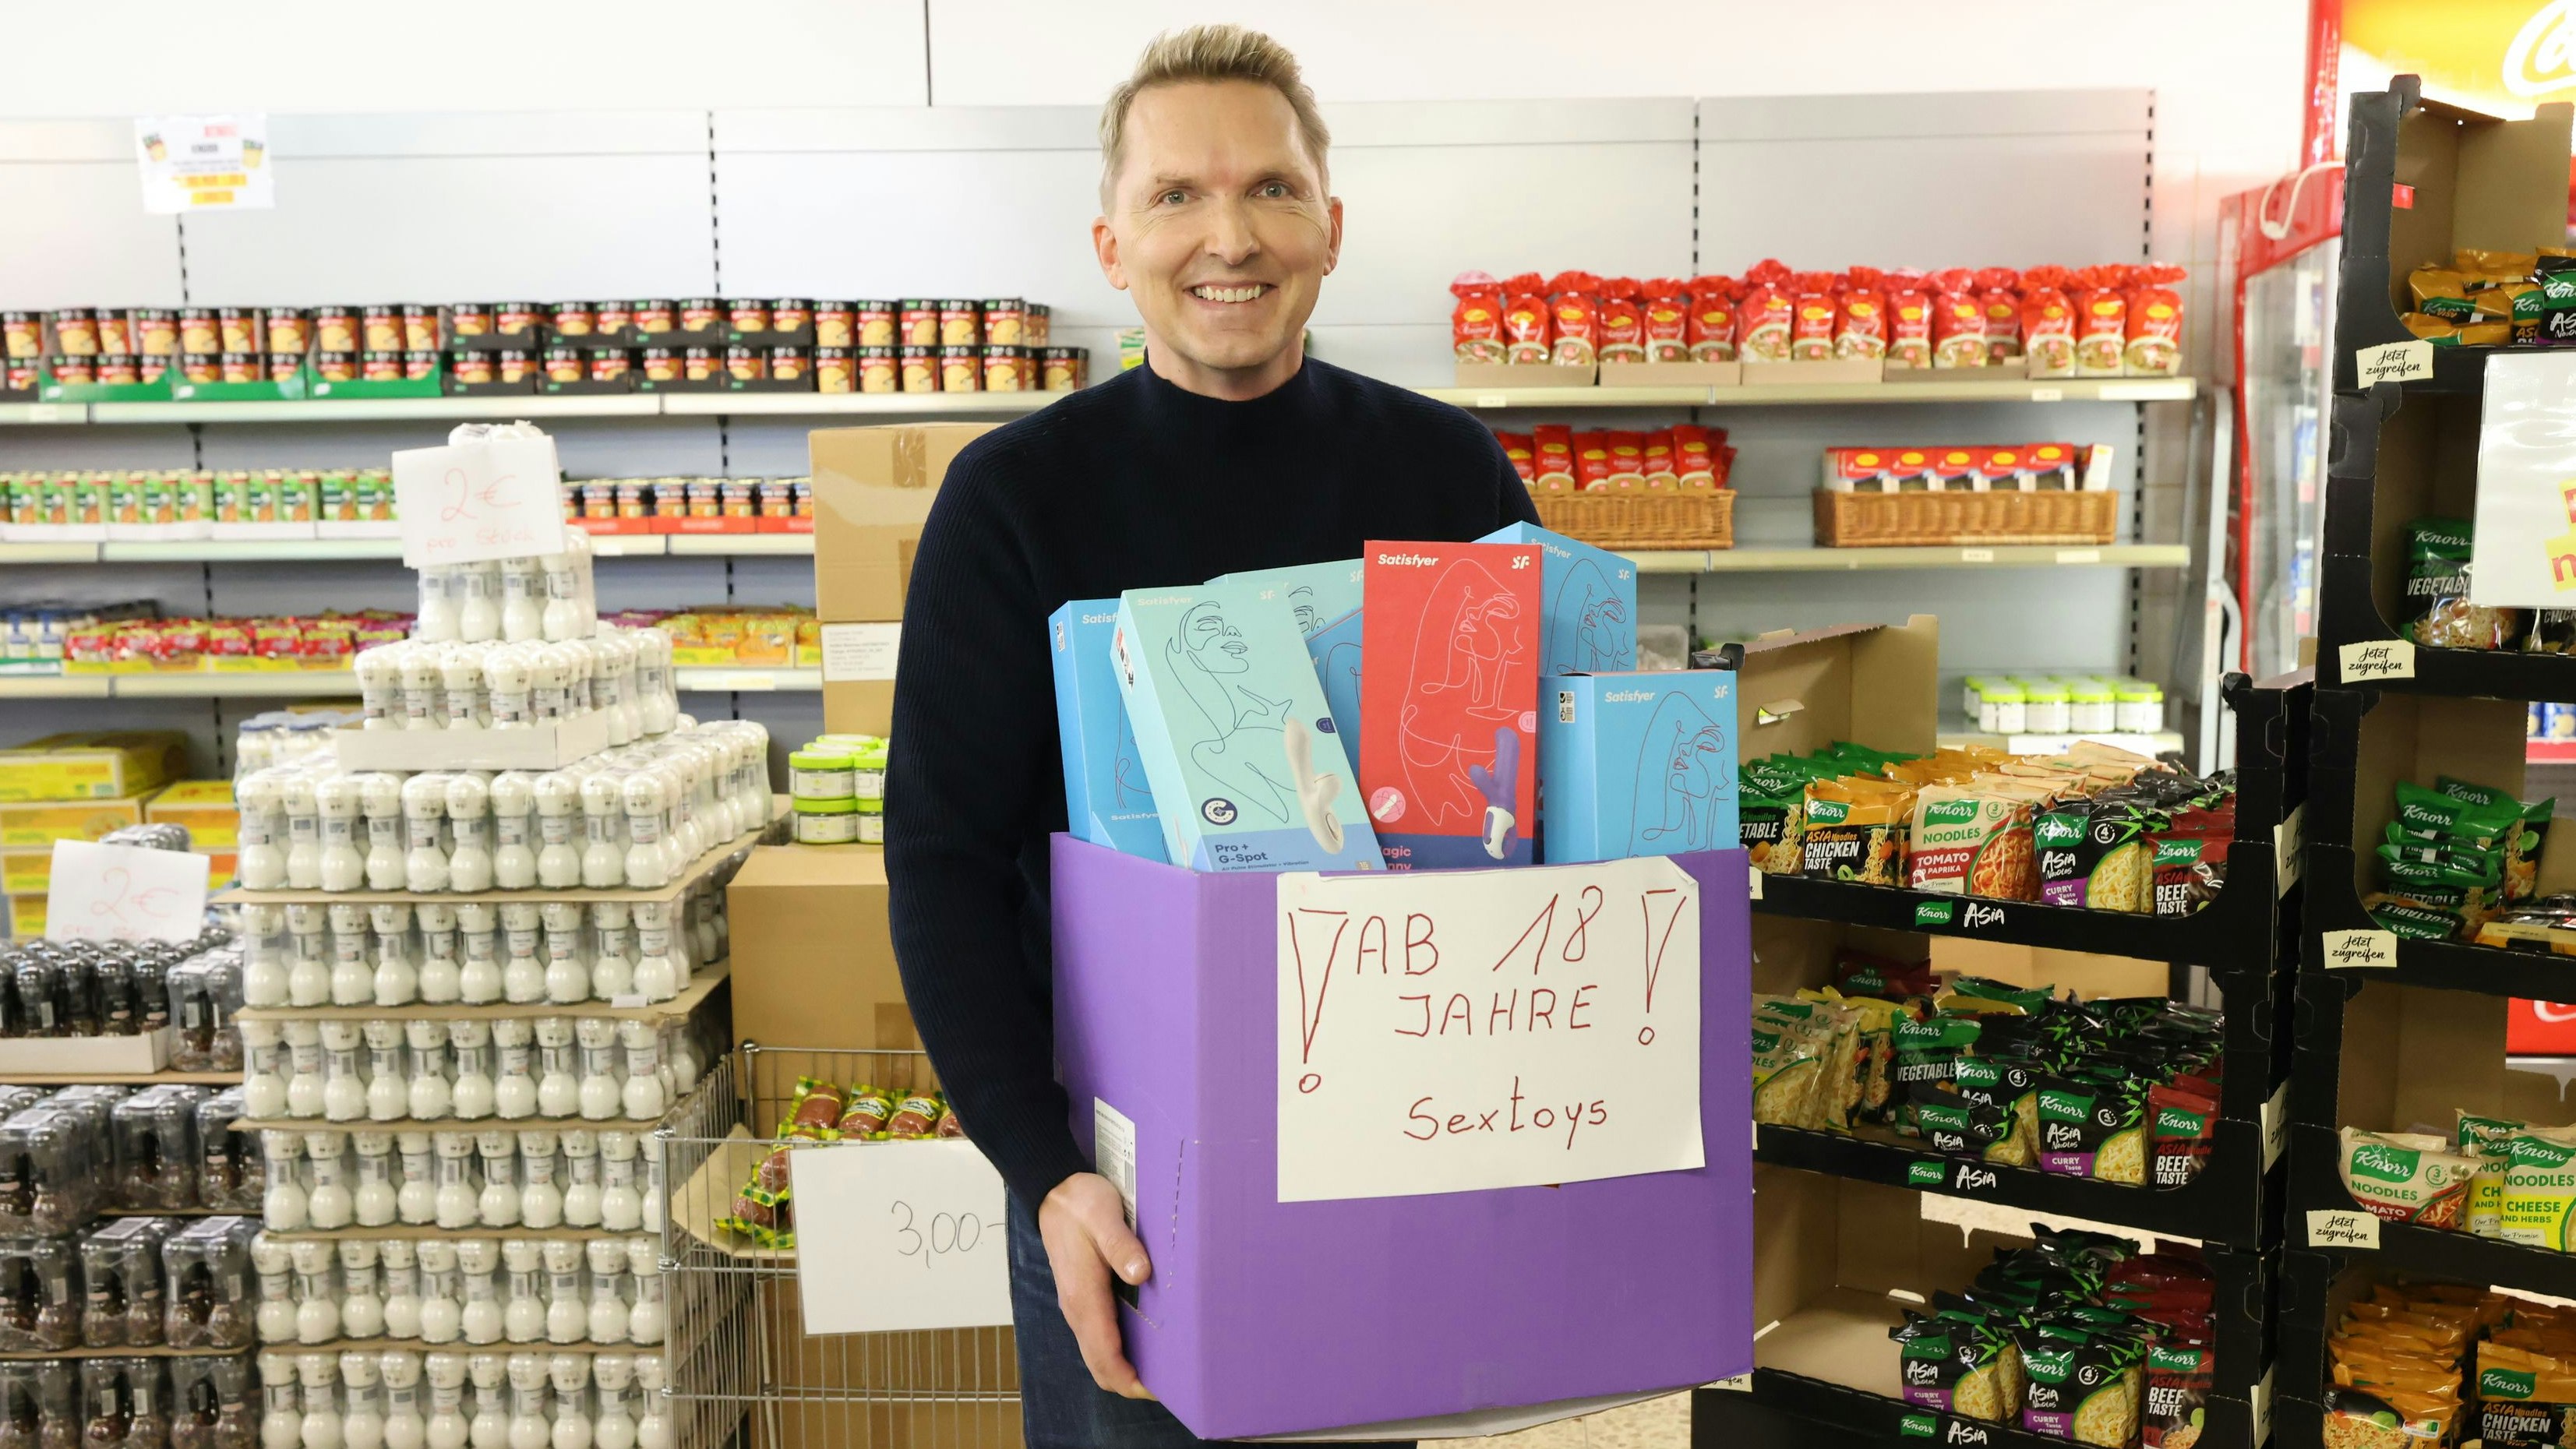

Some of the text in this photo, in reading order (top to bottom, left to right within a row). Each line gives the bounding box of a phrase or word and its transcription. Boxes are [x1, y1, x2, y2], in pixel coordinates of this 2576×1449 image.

[2376, 349, 2411, 366] Jetzt
[2366, 361, 2421, 380] zugreifen
[2415, 530, 2472, 545] Knorr
[1378, 553, 1440, 568] Satisfyer
[1137, 596, 1194, 607] Satisfyer
[1082, 613, 1119, 624] Satisf
[2358, 647, 2393, 662] Jetzt
[2348, 660, 2403, 676] zugreifen
[1604, 690, 1656, 703] Satisfyer
[2446, 783, 2491, 805] Knorr
[1111, 812, 1159, 821] Satisfye
[1807, 801, 1845, 818] Knorr
[2403, 804, 2453, 826] Knorr
[1739, 822, 1780, 839] ETABLE
[1806, 830, 1858, 842] ASIA Noodles
[1923, 827, 1981, 844] NOODLES
[2100, 827, 2109, 836] 4
[1215, 844, 1238, 853] Pro
[1381, 846, 1411, 858] agic
[1805, 841, 1861, 858] CHICKEN
[2158, 844, 2197, 857] Knorr
[1219, 851, 1269, 864] G-Spot
[1804, 858, 1832, 870] TASTE
[1917, 852, 1970, 867] TOMATO
[1928, 865, 1962, 874] PAPRIKA
[2389, 862, 2441, 878] Knorr
[2045, 884, 2073, 896] CURRY
[2156, 883, 2189, 901] BEEF
[1917, 906, 1950, 920] Knorr
[2157, 901, 2187, 915] TASTE
[1492, 885, 1604, 976] 18
[2341, 936, 2375, 950] Jetzt
[2331, 948, 2385, 963] zugreifen
[1395, 985, 1599, 1038] JAHRE
[1899, 1021, 1942, 1037] Knorr
[1897, 1062, 1955, 1082] VEGETABLE
[1403, 1076, 1607, 1150] Sextoys
[2040, 1095, 2085, 1118] Knorr
[1920, 1110, 1965, 1128] Knorr
[2158, 1112, 2200, 1131] Knorr
[2511, 1141, 2567, 1162] Knorr
[2155, 1155, 2192, 1172] BEEF
[2355, 1151, 2411, 1177] Knorr
[1910, 1165, 1943, 1179] Knorr
[2156, 1172, 2188, 1184] TASTE
[2433, 1168, 2440, 1178] 3
[2504, 1174, 2574, 1186] NOODLES
[2352, 1179, 2418, 1200] NOODLES
[2365, 1204, 2406, 1217] MATO
[2507, 1201, 2560, 1213] CHEESE
[2325, 1215, 2359, 1229] Jetzt
[2316, 1229, 2368, 1243] zugreifen
[2022, 1354, 2066, 1377] Knorr
[2084, 1369, 2092, 1377] 4
[2482, 1373, 2531, 1394] Knorr
[2148, 1387, 2186, 1404] BEEF
[2148, 1402, 2182, 1417] TASTE
[2482, 1402, 2514, 1416] ASIA
[1902, 1419, 1934, 1433] Knorr
[2033, 1415, 2059, 1423] CURRY
[2482, 1413, 2551, 1433] CHICKEN
[2482, 1428, 2517, 1441] TASTE
